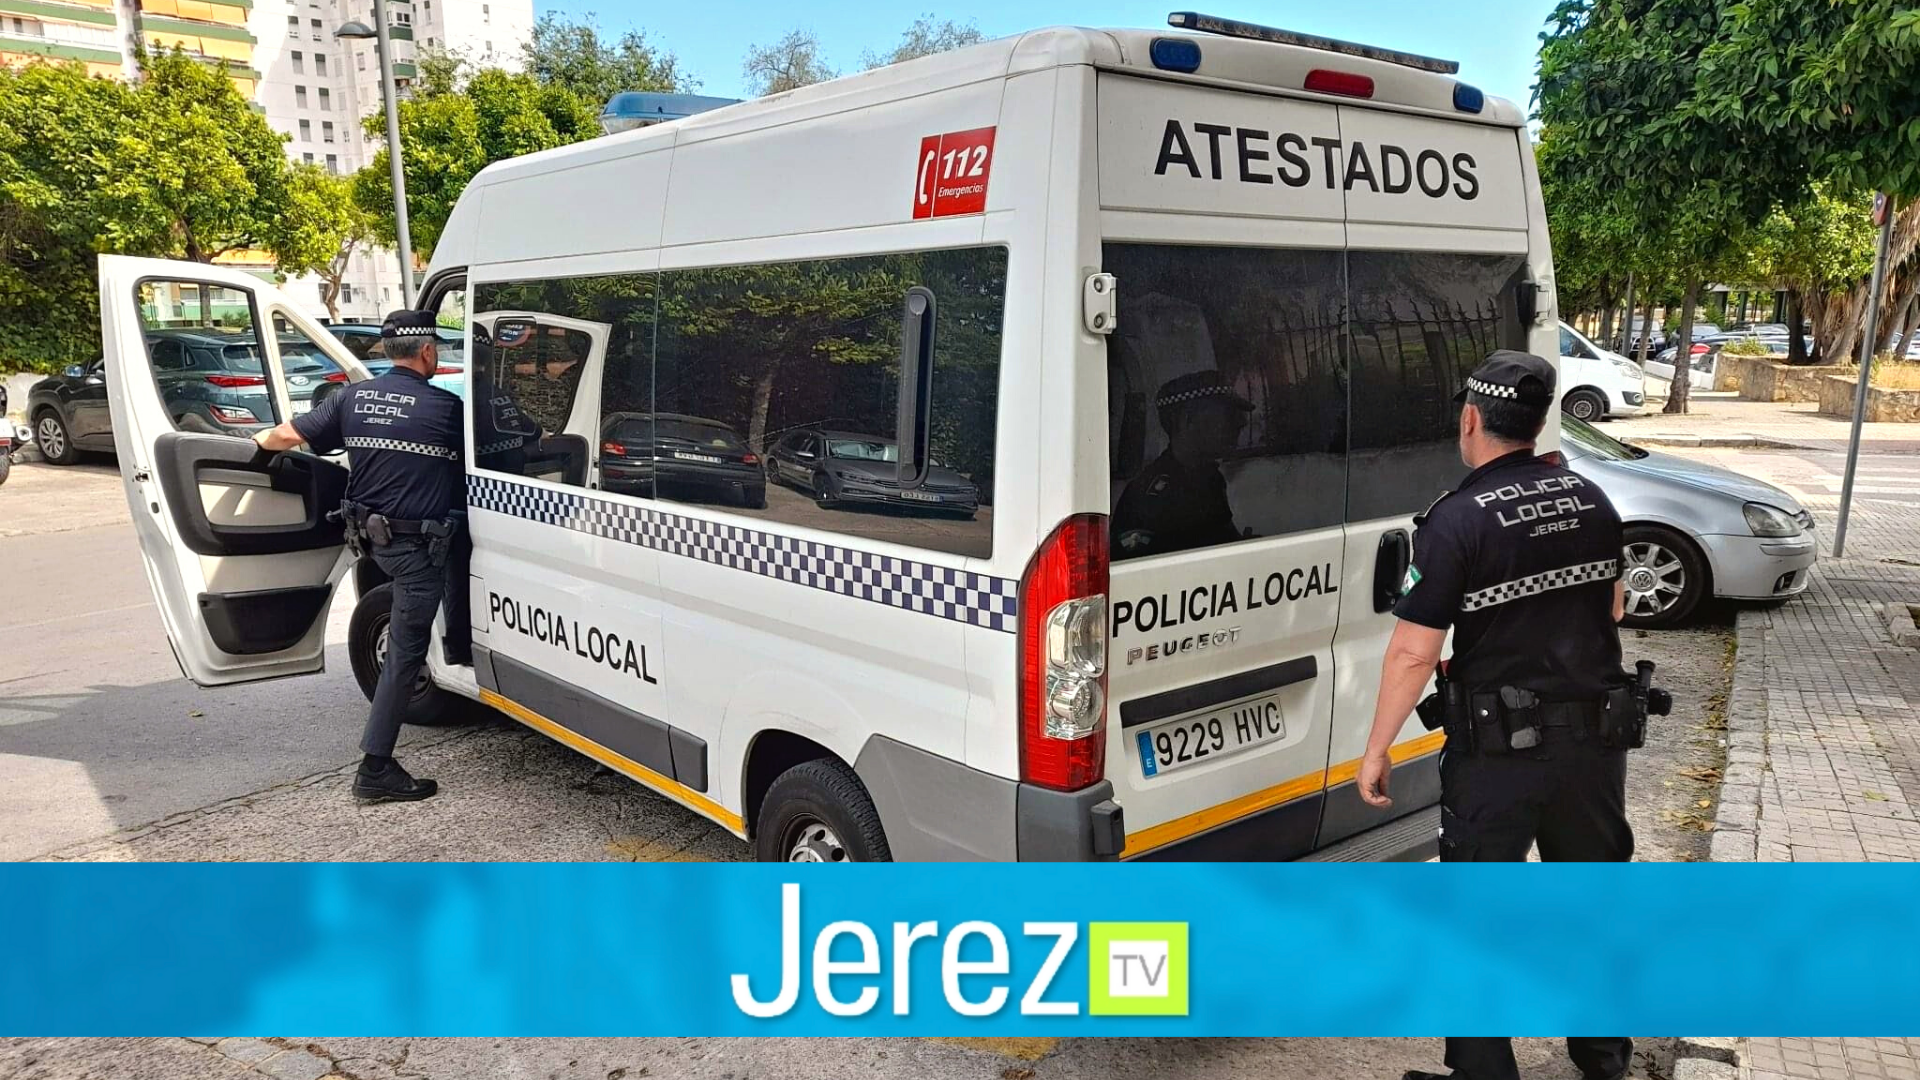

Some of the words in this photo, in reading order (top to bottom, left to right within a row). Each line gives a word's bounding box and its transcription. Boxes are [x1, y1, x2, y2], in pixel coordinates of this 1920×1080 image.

[943, 145, 988, 179] 112
[1154, 119, 1480, 200] ATESTADOS
[938, 183, 984, 198] Emergencias
[354, 390, 416, 406] POLICIA
[354, 403, 409, 418] LOCAL
[362, 417, 393, 425] JEREZ
[1474, 475, 1585, 508] POLICIA
[1496, 495, 1596, 527] LOCAL
[1529, 518, 1581, 537] JEREZ
[1112, 581, 1238, 638] POLICIA
[1247, 563, 1338, 610] LOCAL
[489, 591, 570, 651] POLICIA
[574, 621, 657, 685] LOCAL
[1126, 626, 1242, 666] PEUGEOT
[1156, 717, 1224, 766] 9229
[1233, 701, 1281, 745] HVC
